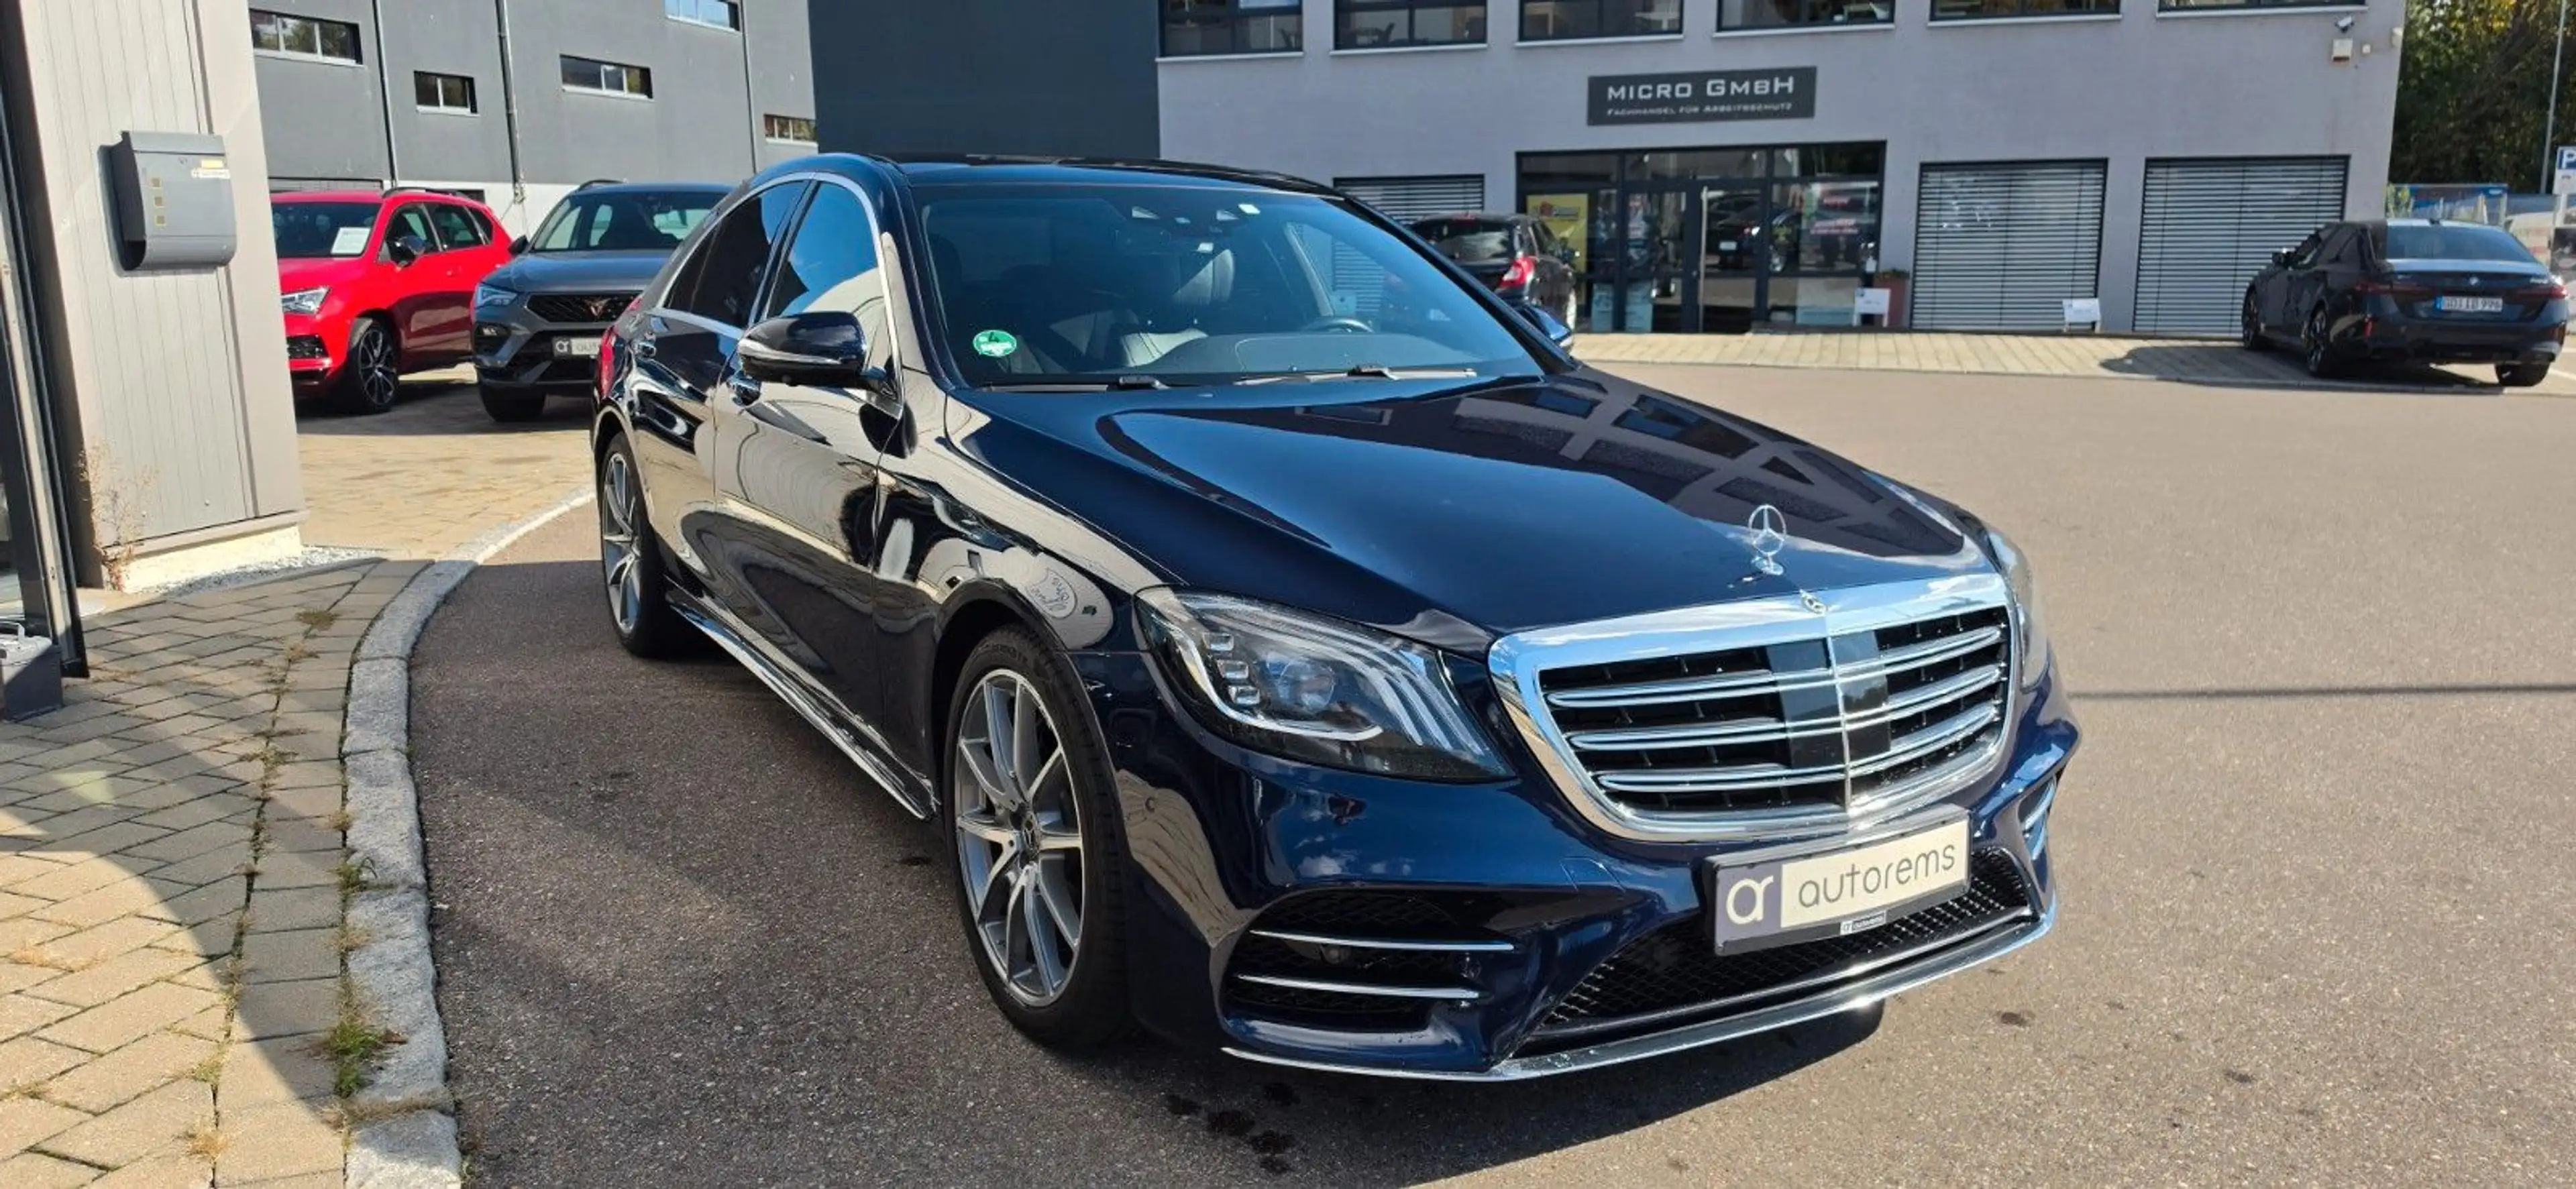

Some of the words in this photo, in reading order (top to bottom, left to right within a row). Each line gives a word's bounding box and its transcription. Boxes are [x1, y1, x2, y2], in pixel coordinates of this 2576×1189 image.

[1607, 82, 1693, 101] MICRO
[2562, 150, 2576, 169] P
[1798, 843, 1955, 908] autorems
